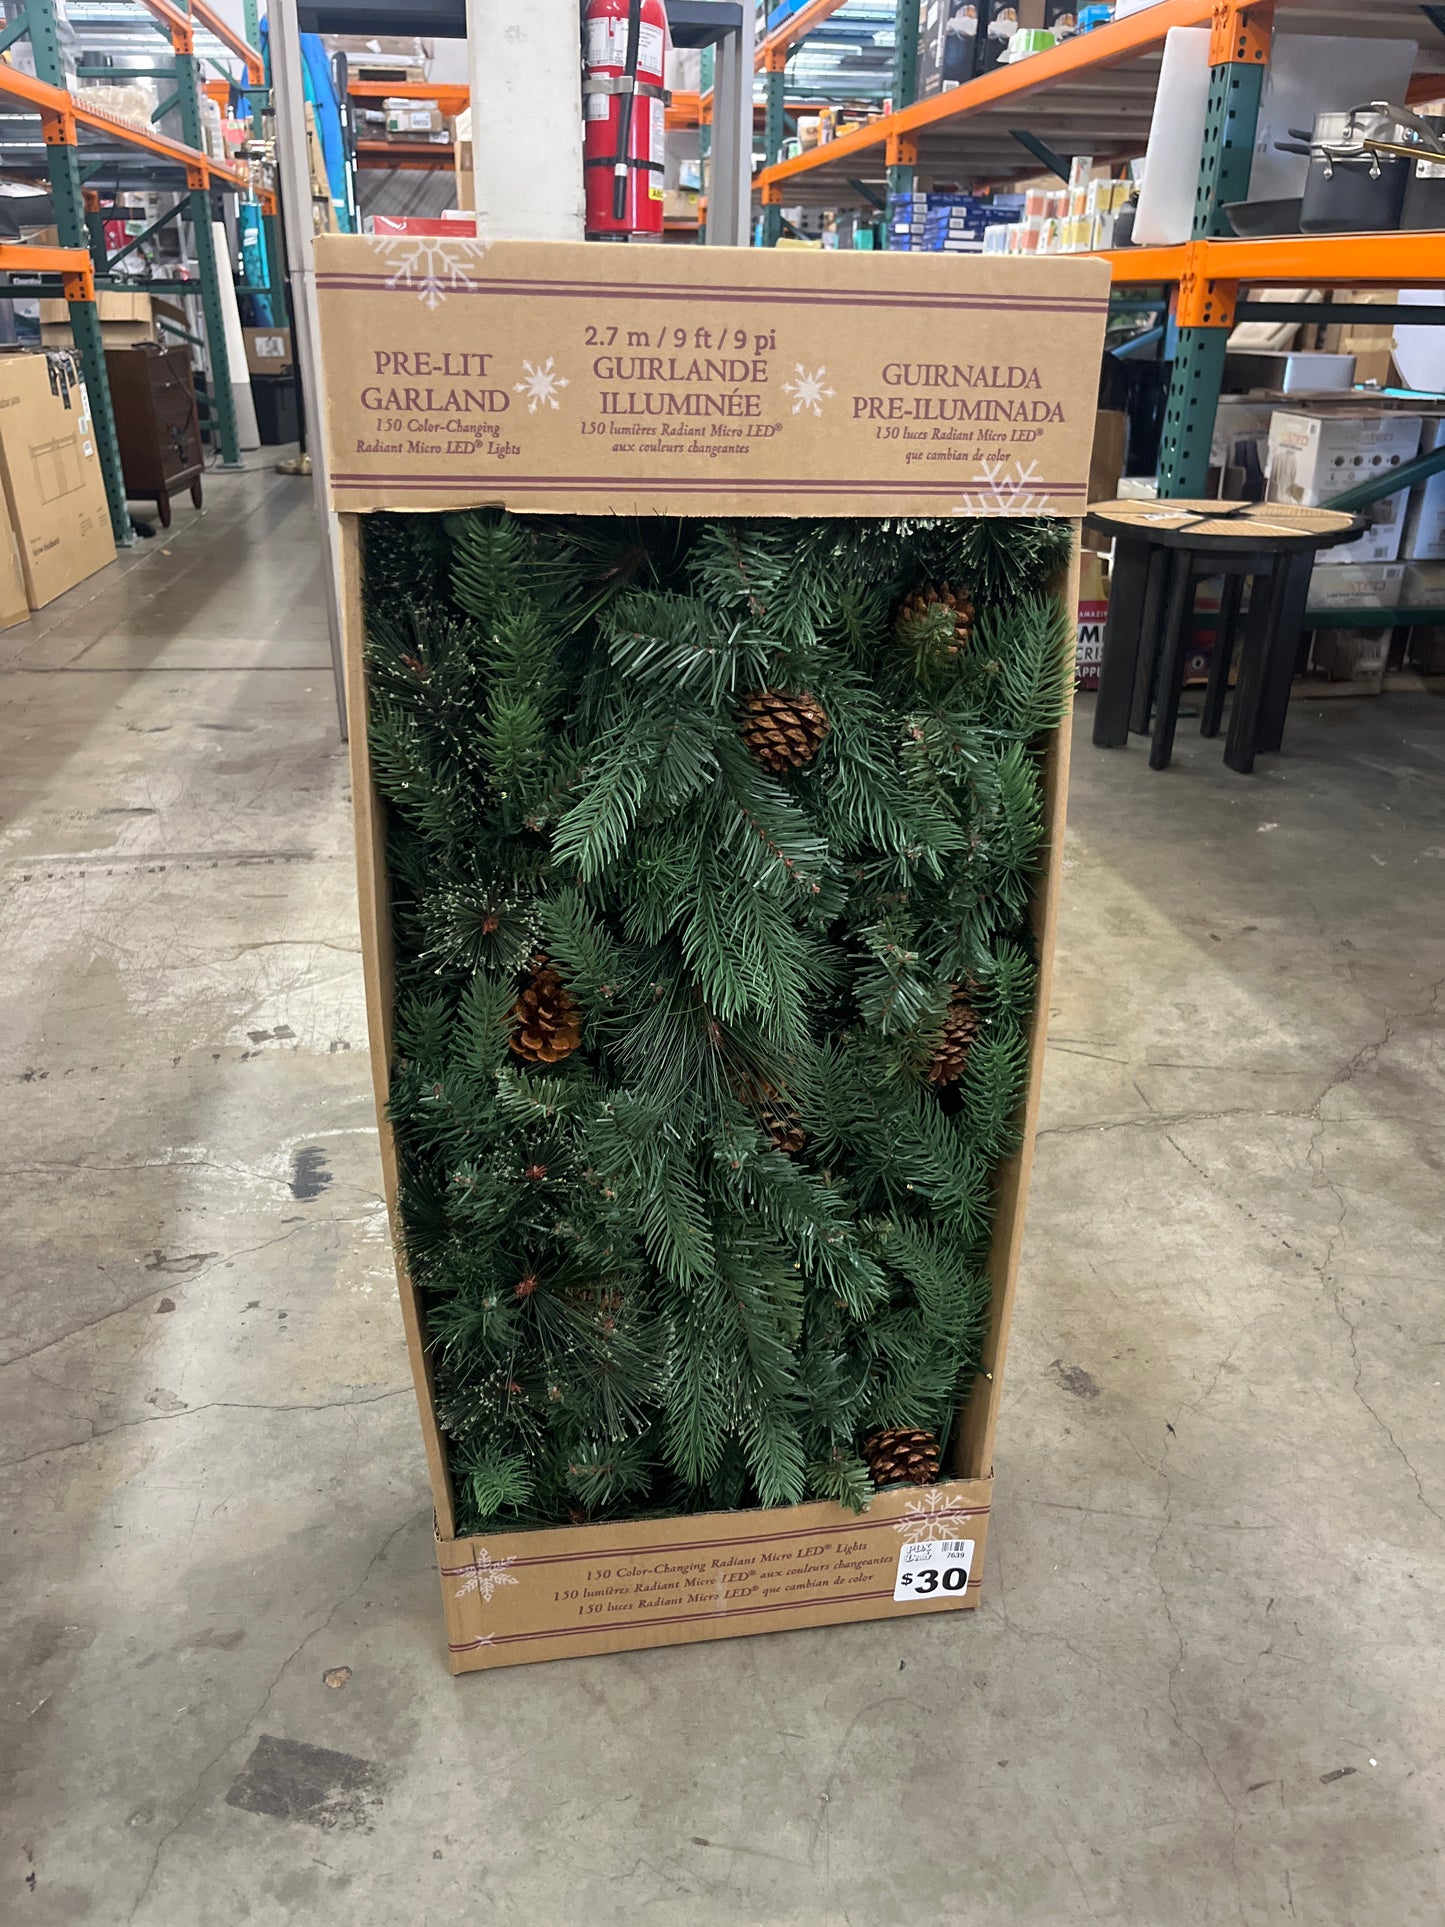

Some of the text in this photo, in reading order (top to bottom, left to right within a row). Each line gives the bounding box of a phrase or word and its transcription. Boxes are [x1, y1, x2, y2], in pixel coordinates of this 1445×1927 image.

[585, 326, 618, 346] 2.7
[627, 330, 650, 347] m
[674, 328, 687, 348] 9
[694, 327, 712, 349] ft
[734, 330, 747, 349] 9
[754, 329, 776, 355] pi
[374, 351, 493, 376] PRE-LIT
[593, 356, 768, 383] GUIRLANDE
[882, 363, 1042, 389] GUIRNALDA
[360, 387, 510, 412] GARLAND
[600, 388, 762, 416] ILLUMINÉE
[852, 396, 1066, 423] PRE-ILUMINADA
[376, 418, 500, 438] 150 Color-Changing
[580, 422, 605, 435] 150
[610, 421, 656, 436] lumières
[661, 423, 706, 436] Radiant
[710, 424, 743, 437] Micro
[876, 426, 899, 439] 150
[903, 426, 927, 440] luces
[931, 427, 973, 441] Radiant
[976, 429, 1007, 441] Micro
[356, 439, 402, 453] Radiant
[408, 440, 442, 454] Micro
[486, 441, 520, 459] Lights
[612, 439, 750, 457] aux couleurs changeantes
[905, 448, 1011, 464] que cambian de color
[587, 1569, 611, 1580] 150
[616, 1562, 706, 1578] Color-Changing
[711, 1557, 756, 1568] Radiant
[760, 1554, 792, 1563] Micro
[836, 1541, 868, 1554] Lights
[554, 1589, 578, 1601] 150
[583, 1586, 629, 1598] lumières
[634, 1581, 679, 1593] Radiant
[684, 1576, 716, 1588] Micro
[760, 1571, 782, 1579] aux
[786, 1562, 830, 1575] couleurs
[833, 1555, 893, 1570] changeantes
[901, 1568, 967, 1594] $30
[579, 1603, 603, 1615] 150
[607, 1602, 633, 1612] luces
[637, 1598, 682, 1609] Radiant
[687, 1593, 720, 1603] Micro
[763, 1586, 781, 1597] que
[785, 1579, 829, 1592] cambian
[833, 1577, 845, 1585] de
[848, 1574, 874, 1584] color
